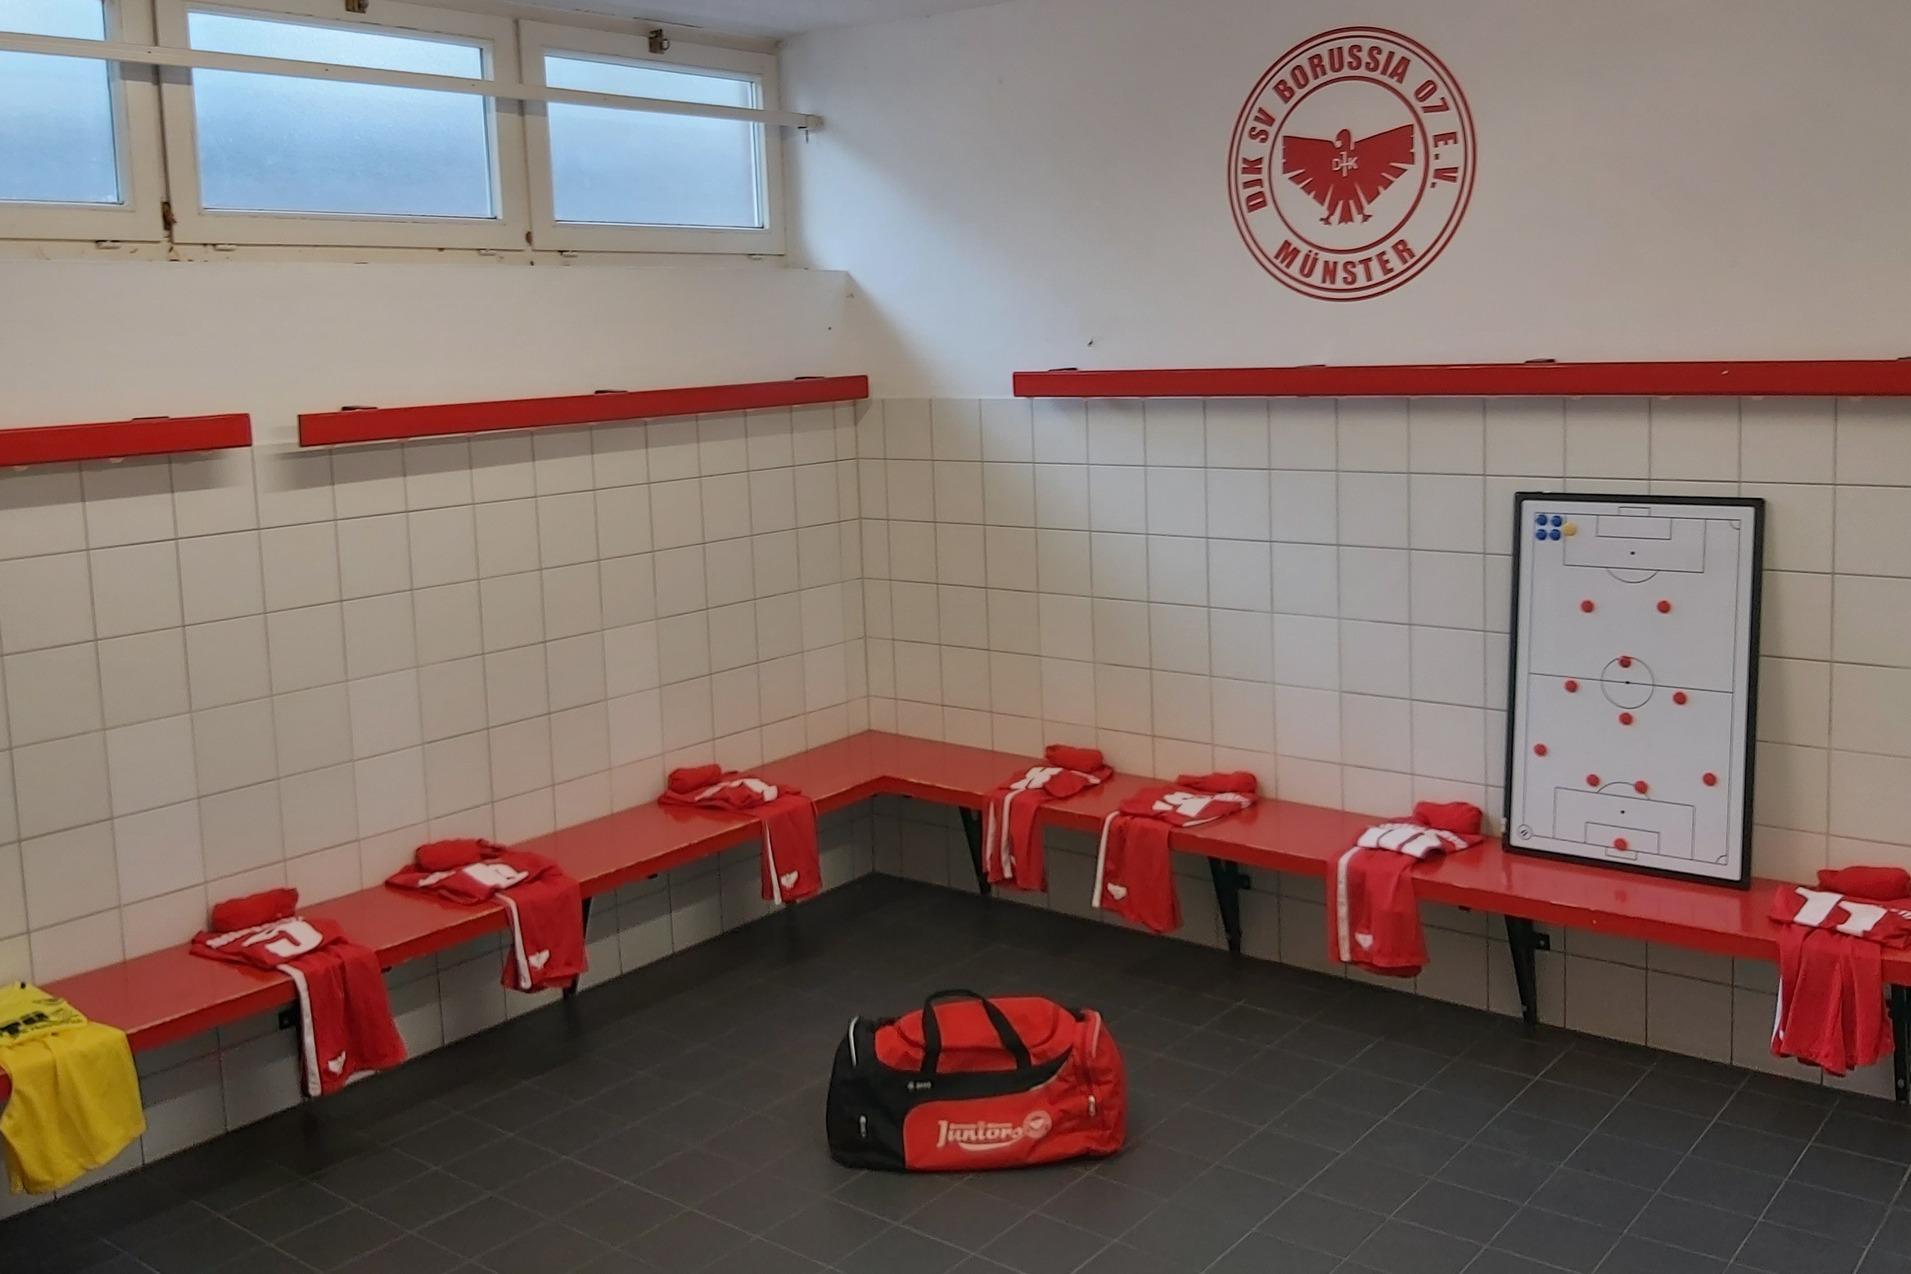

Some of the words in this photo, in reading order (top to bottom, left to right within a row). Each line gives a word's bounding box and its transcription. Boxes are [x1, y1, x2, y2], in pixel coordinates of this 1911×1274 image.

[1273, 44, 1411, 104] BORUSSIA
[1413, 79, 1450, 113] 07
[1248, 107, 1276, 144] SV
[1241, 156, 1268, 213] DJK
[1273, 239, 1416, 285] MÜNSTER
[936, 1120, 1024, 1149] Juniors
